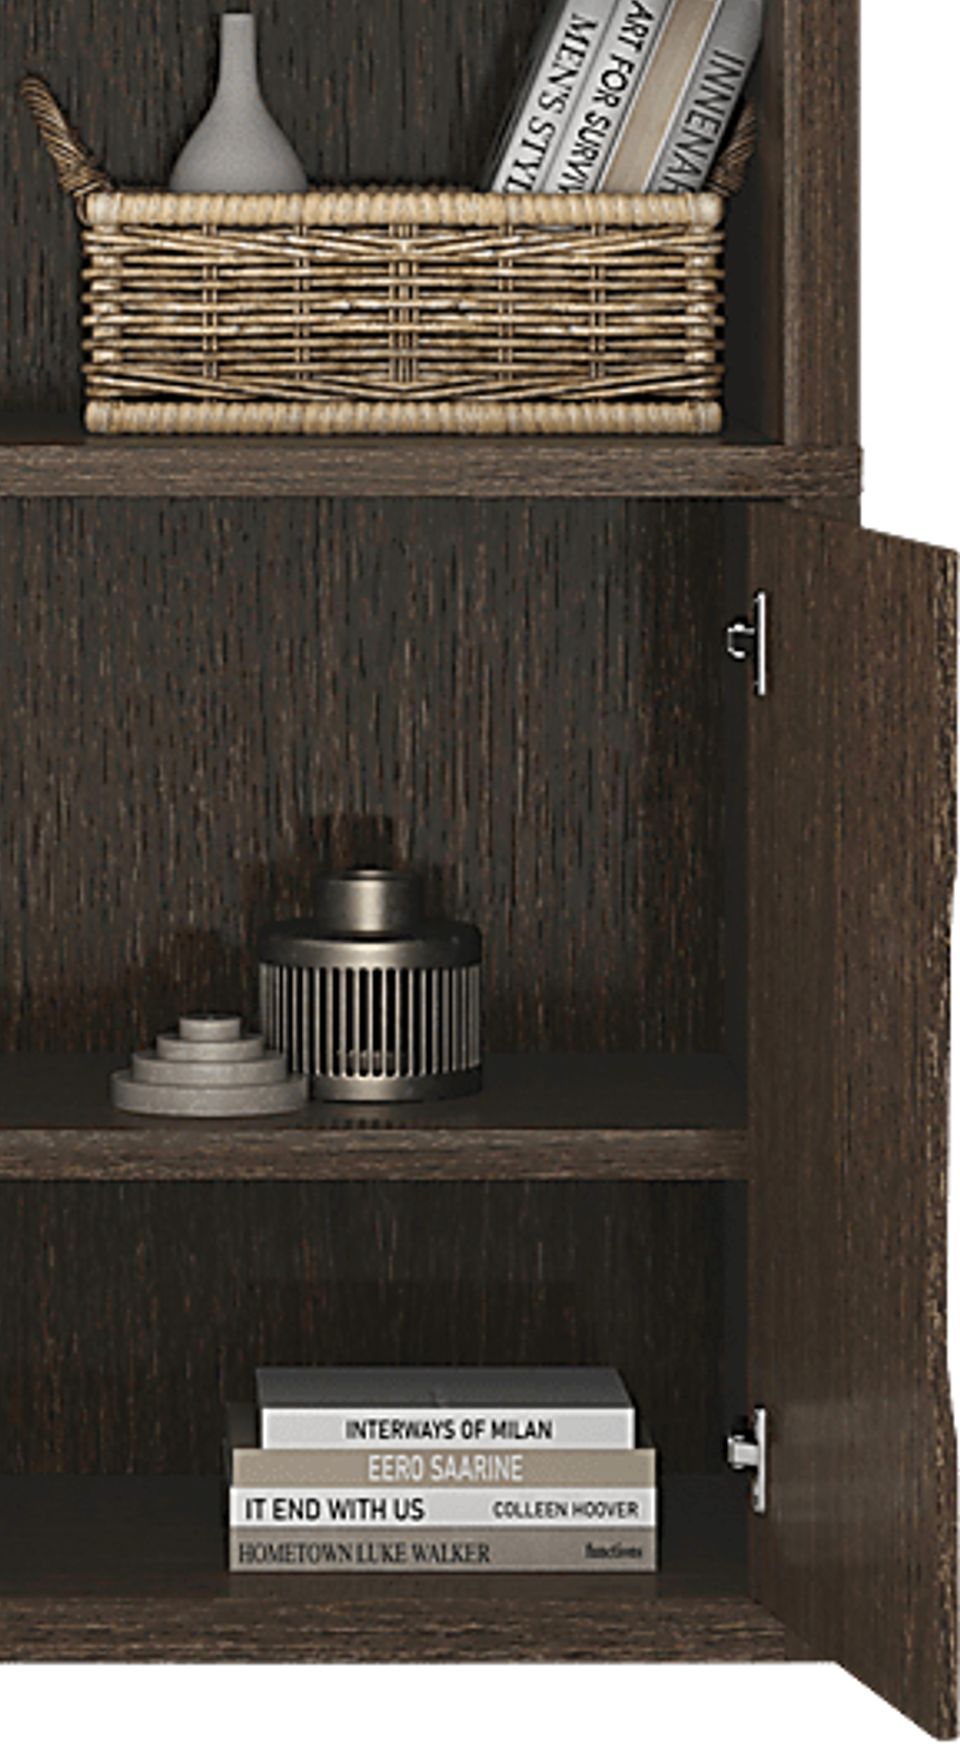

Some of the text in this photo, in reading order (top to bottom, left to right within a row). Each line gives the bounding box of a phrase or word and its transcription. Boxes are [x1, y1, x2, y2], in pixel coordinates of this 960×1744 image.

[617, 0, 655, 52] ART
[538, 13, 598, 115] MEN'S
[592, 53, 636, 108] FOR
[345, 1419, 553, 1440] INTERWAYS OF MILAN
[367, 1455, 524, 1481] EERO SAARINE
[245, 1498, 426, 1521] IT END WITH US
[493, 1502, 639, 1518] COLLEEN HOOVER
[239, 1542, 490, 1564] HOMETOWN LUKE WALKER
